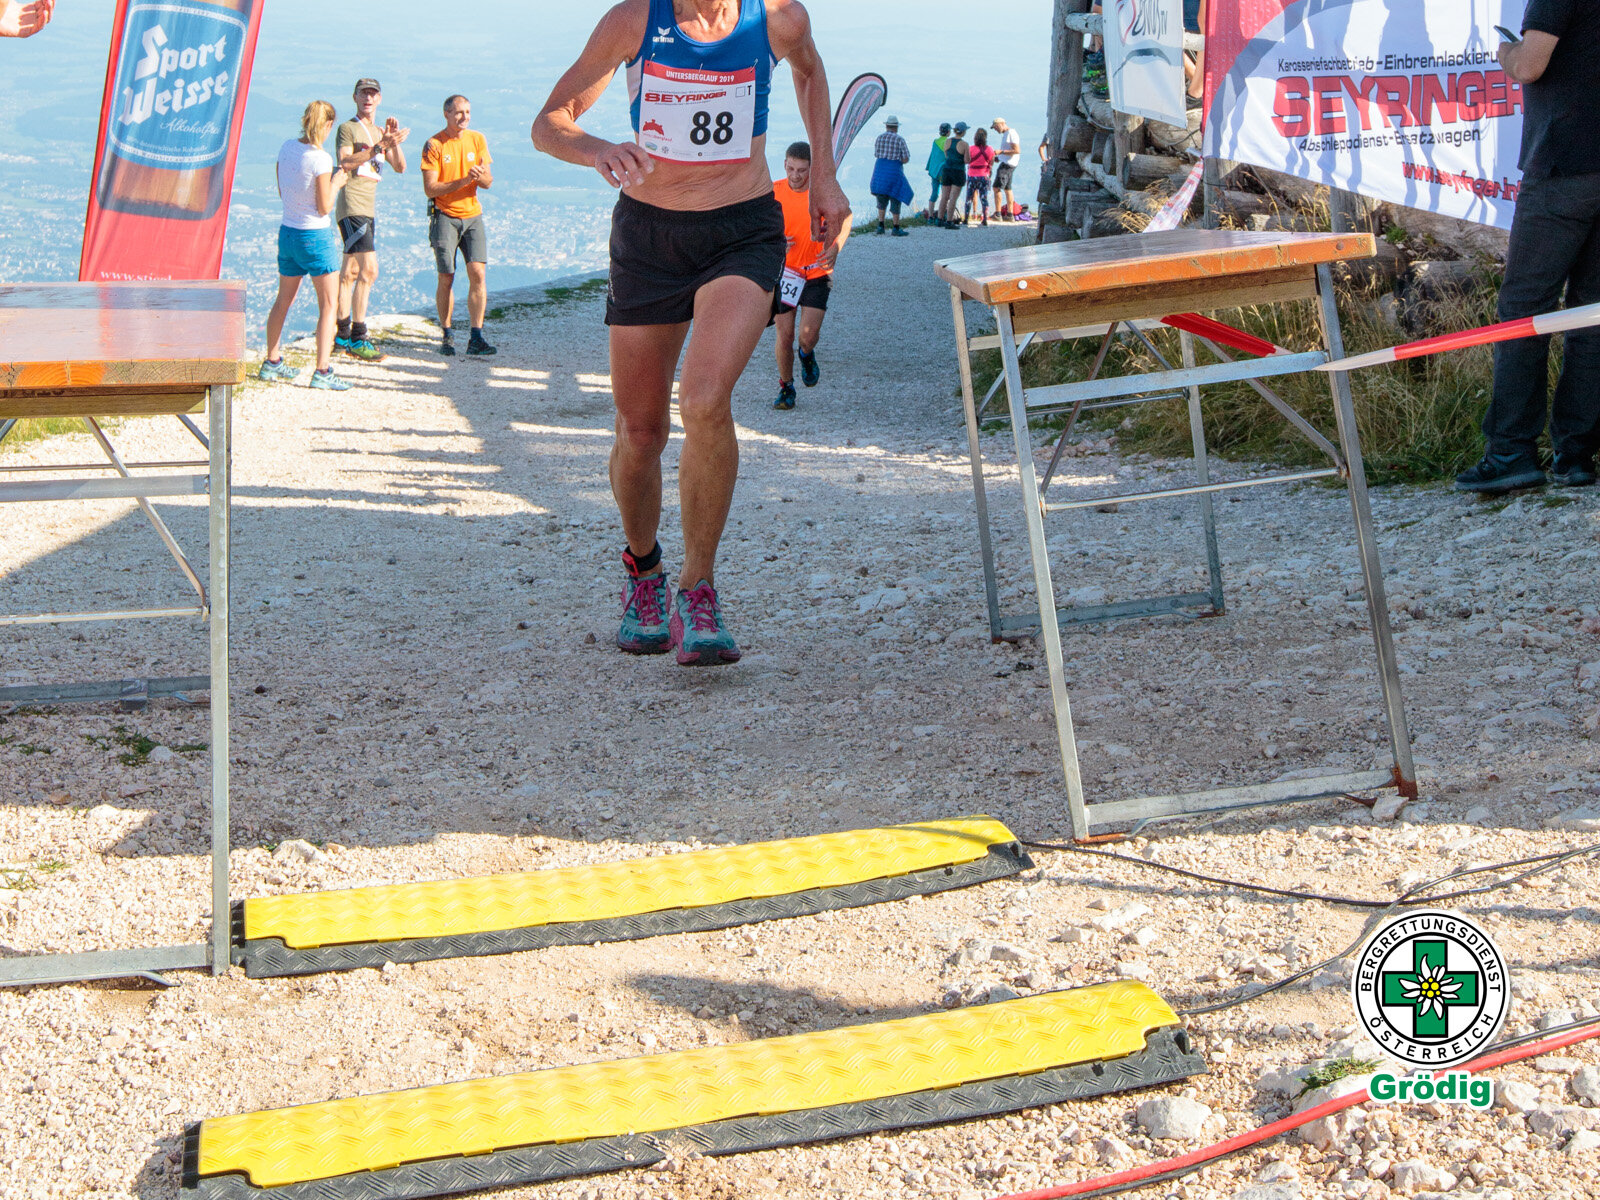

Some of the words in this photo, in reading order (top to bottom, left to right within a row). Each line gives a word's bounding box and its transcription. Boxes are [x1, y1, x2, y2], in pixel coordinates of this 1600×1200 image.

[135, 24, 227, 81] Sport
[1278, 50, 1500, 72] Karosseriefachbetrieb-Einbrennlackieru
[665, 70, 718, 83] UNTERSBERGLAUF
[719, 75, 735, 83] 2019
[117, 70, 230, 126] Weisse
[644, 91, 727, 103] SEYRINGER
[1271, 69, 1525, 138] SEYRINGER
[690, 111, 734, 146] 88
